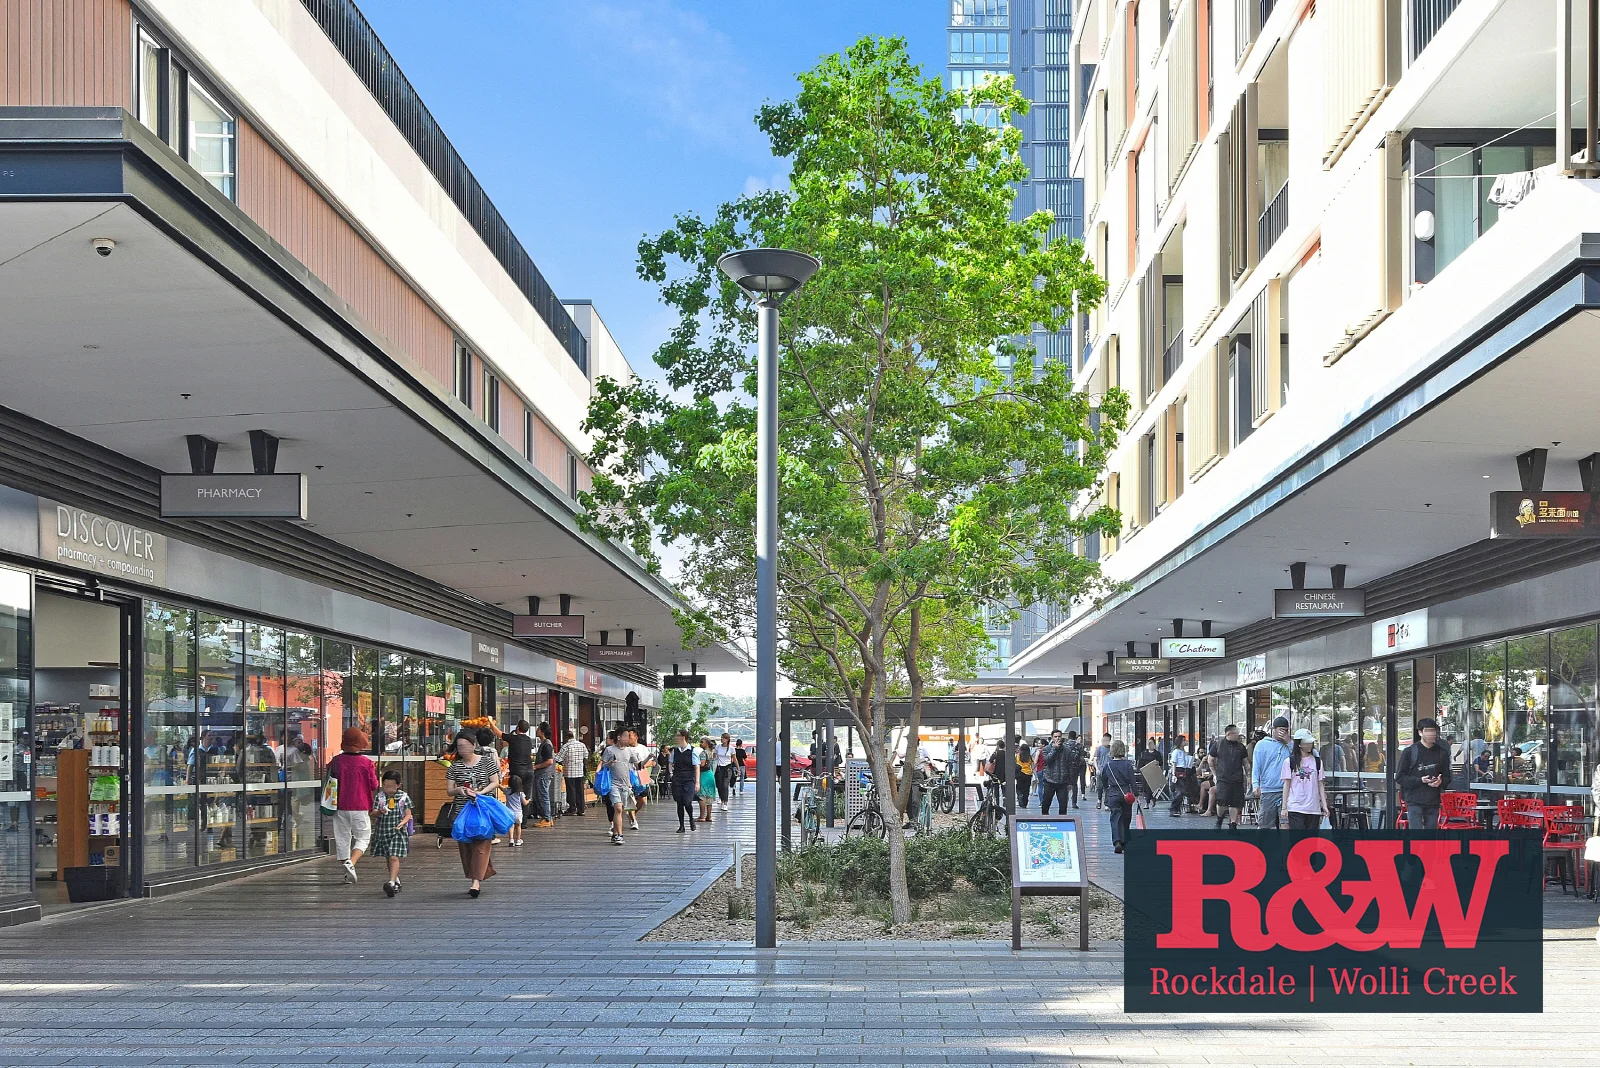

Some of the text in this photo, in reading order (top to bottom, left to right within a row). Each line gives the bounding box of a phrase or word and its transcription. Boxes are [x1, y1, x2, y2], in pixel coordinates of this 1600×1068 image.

[197, 488, 263, 498] PHARMACY
[56, 505, 155, 562] DISCOVER
[57, 544, 98, 568] pharmacy
[107, 557, 155, 583] compounding
[1304, 593, 1336, 601] CHINESE
[1295, 601, 1345, 611] RESTAURANT
[1178, 644, 1218, 654] Chatime
